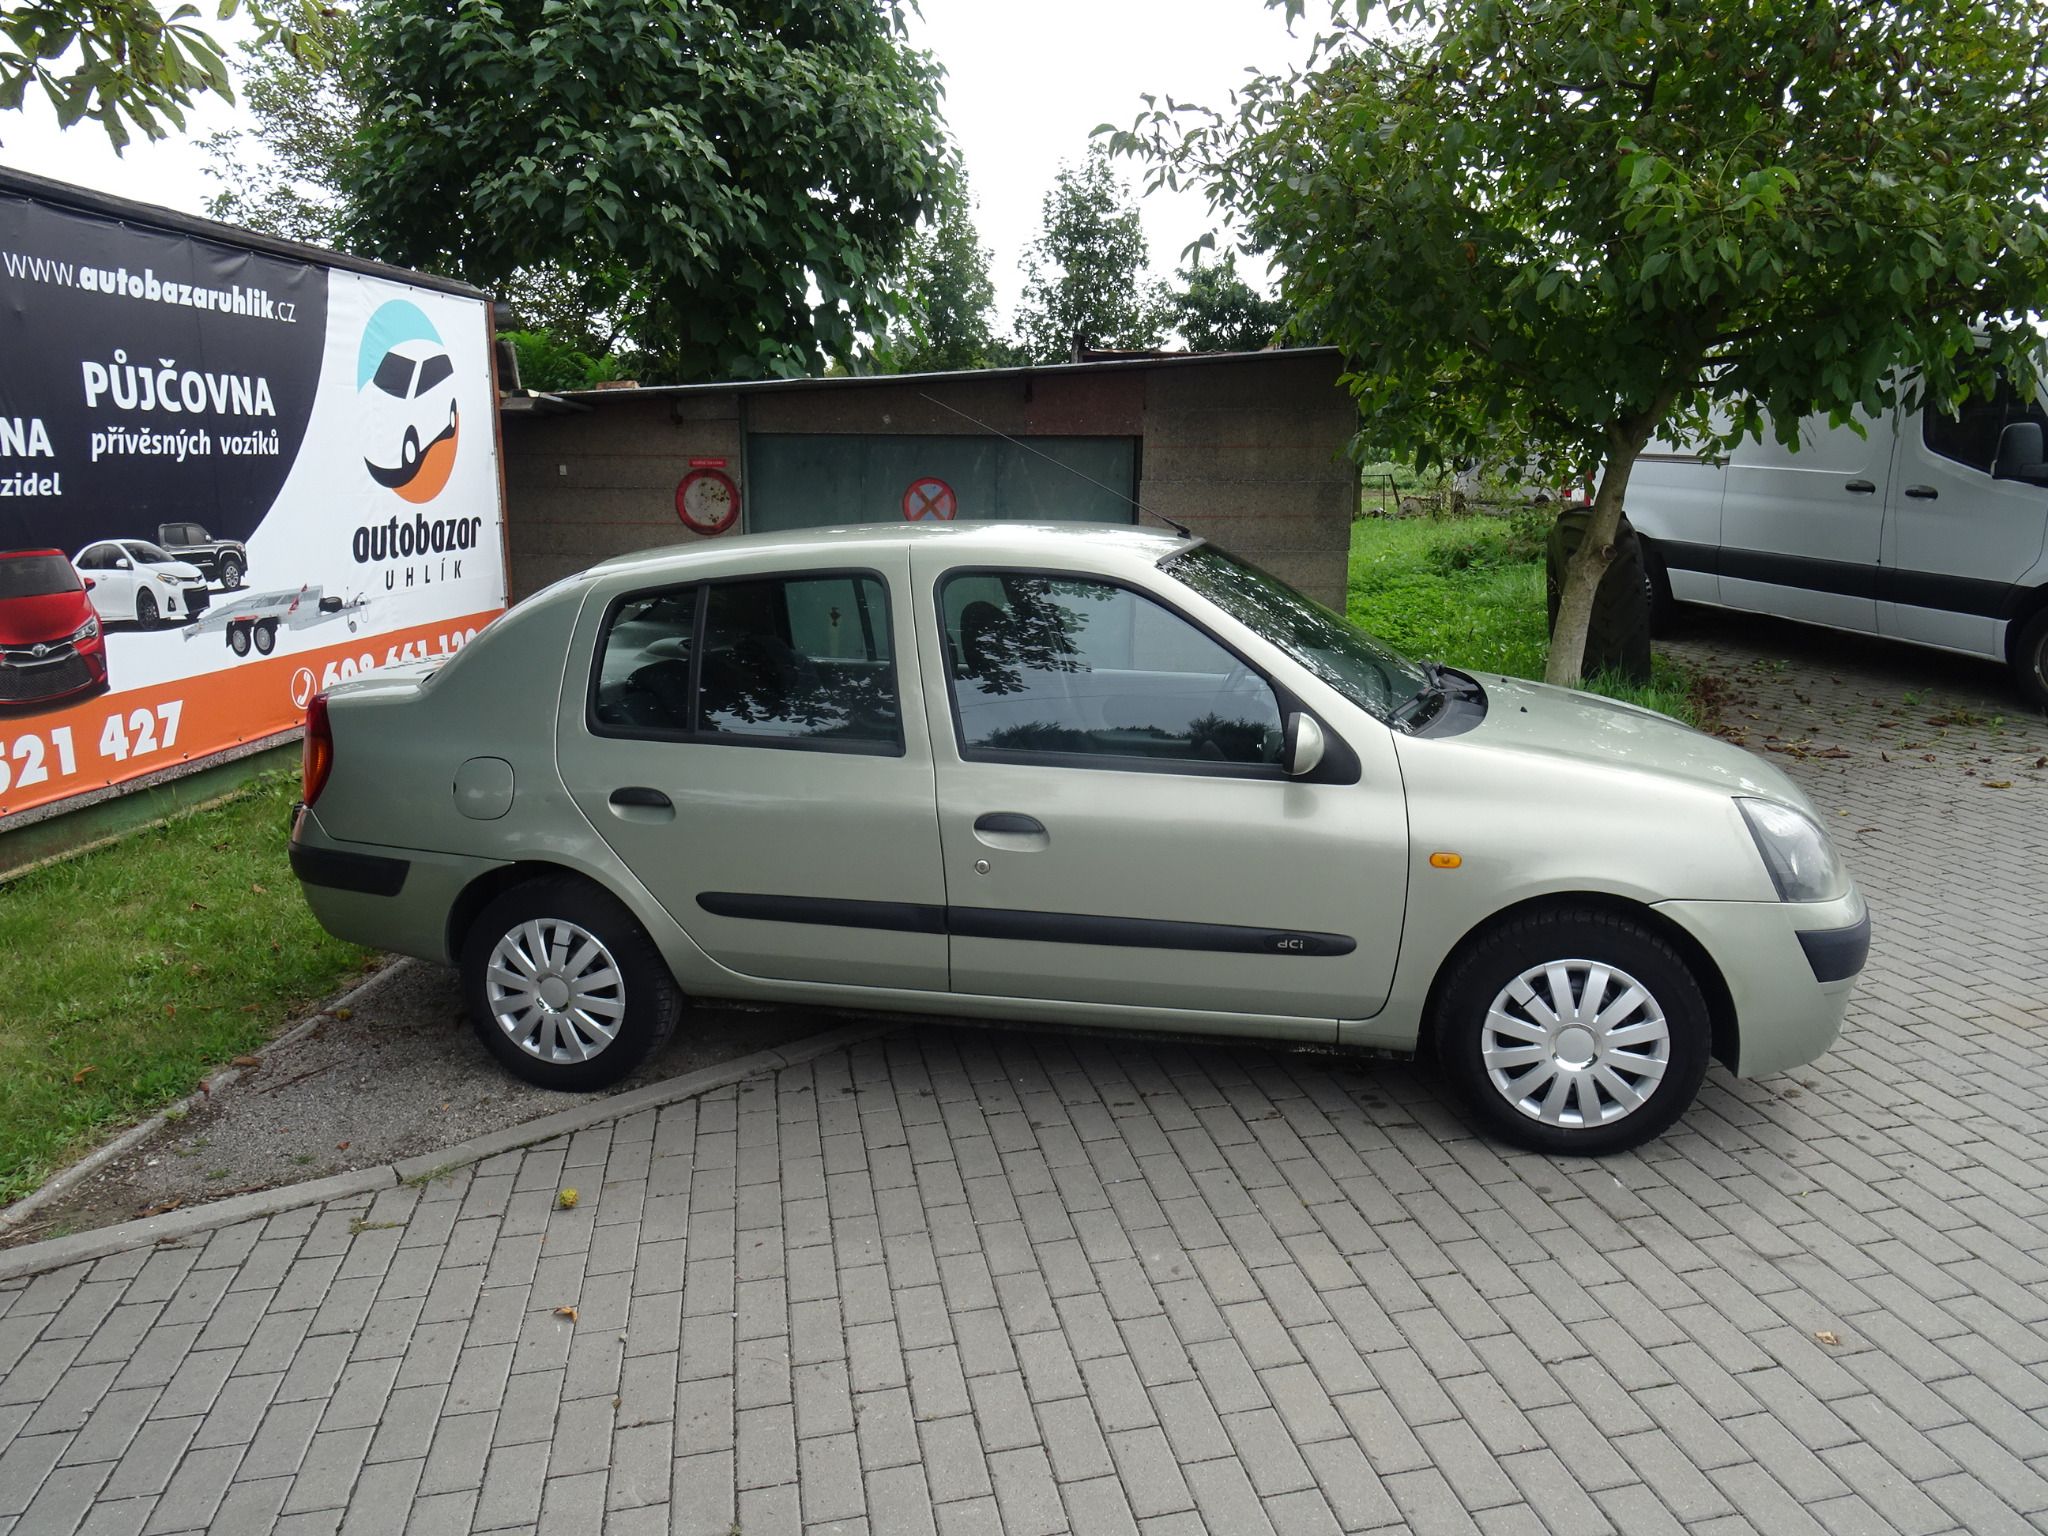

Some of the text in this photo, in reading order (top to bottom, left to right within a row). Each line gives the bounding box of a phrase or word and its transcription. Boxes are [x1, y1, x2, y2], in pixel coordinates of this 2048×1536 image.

[3, 251, 297, 323] www.autobazaruhlik.cz
[81, 349, 277, 417] PŮJČOVNA
[0, 416, 55, 457] NA
[91, 426, 279, 463] přívěsných vozíků
[352, 512, 481, 564] autobazar
[385, 557, 462, 591] UHLÍK
[99, 700, 184, 762] 427
[1277, 939, 1304, 949] dCi
